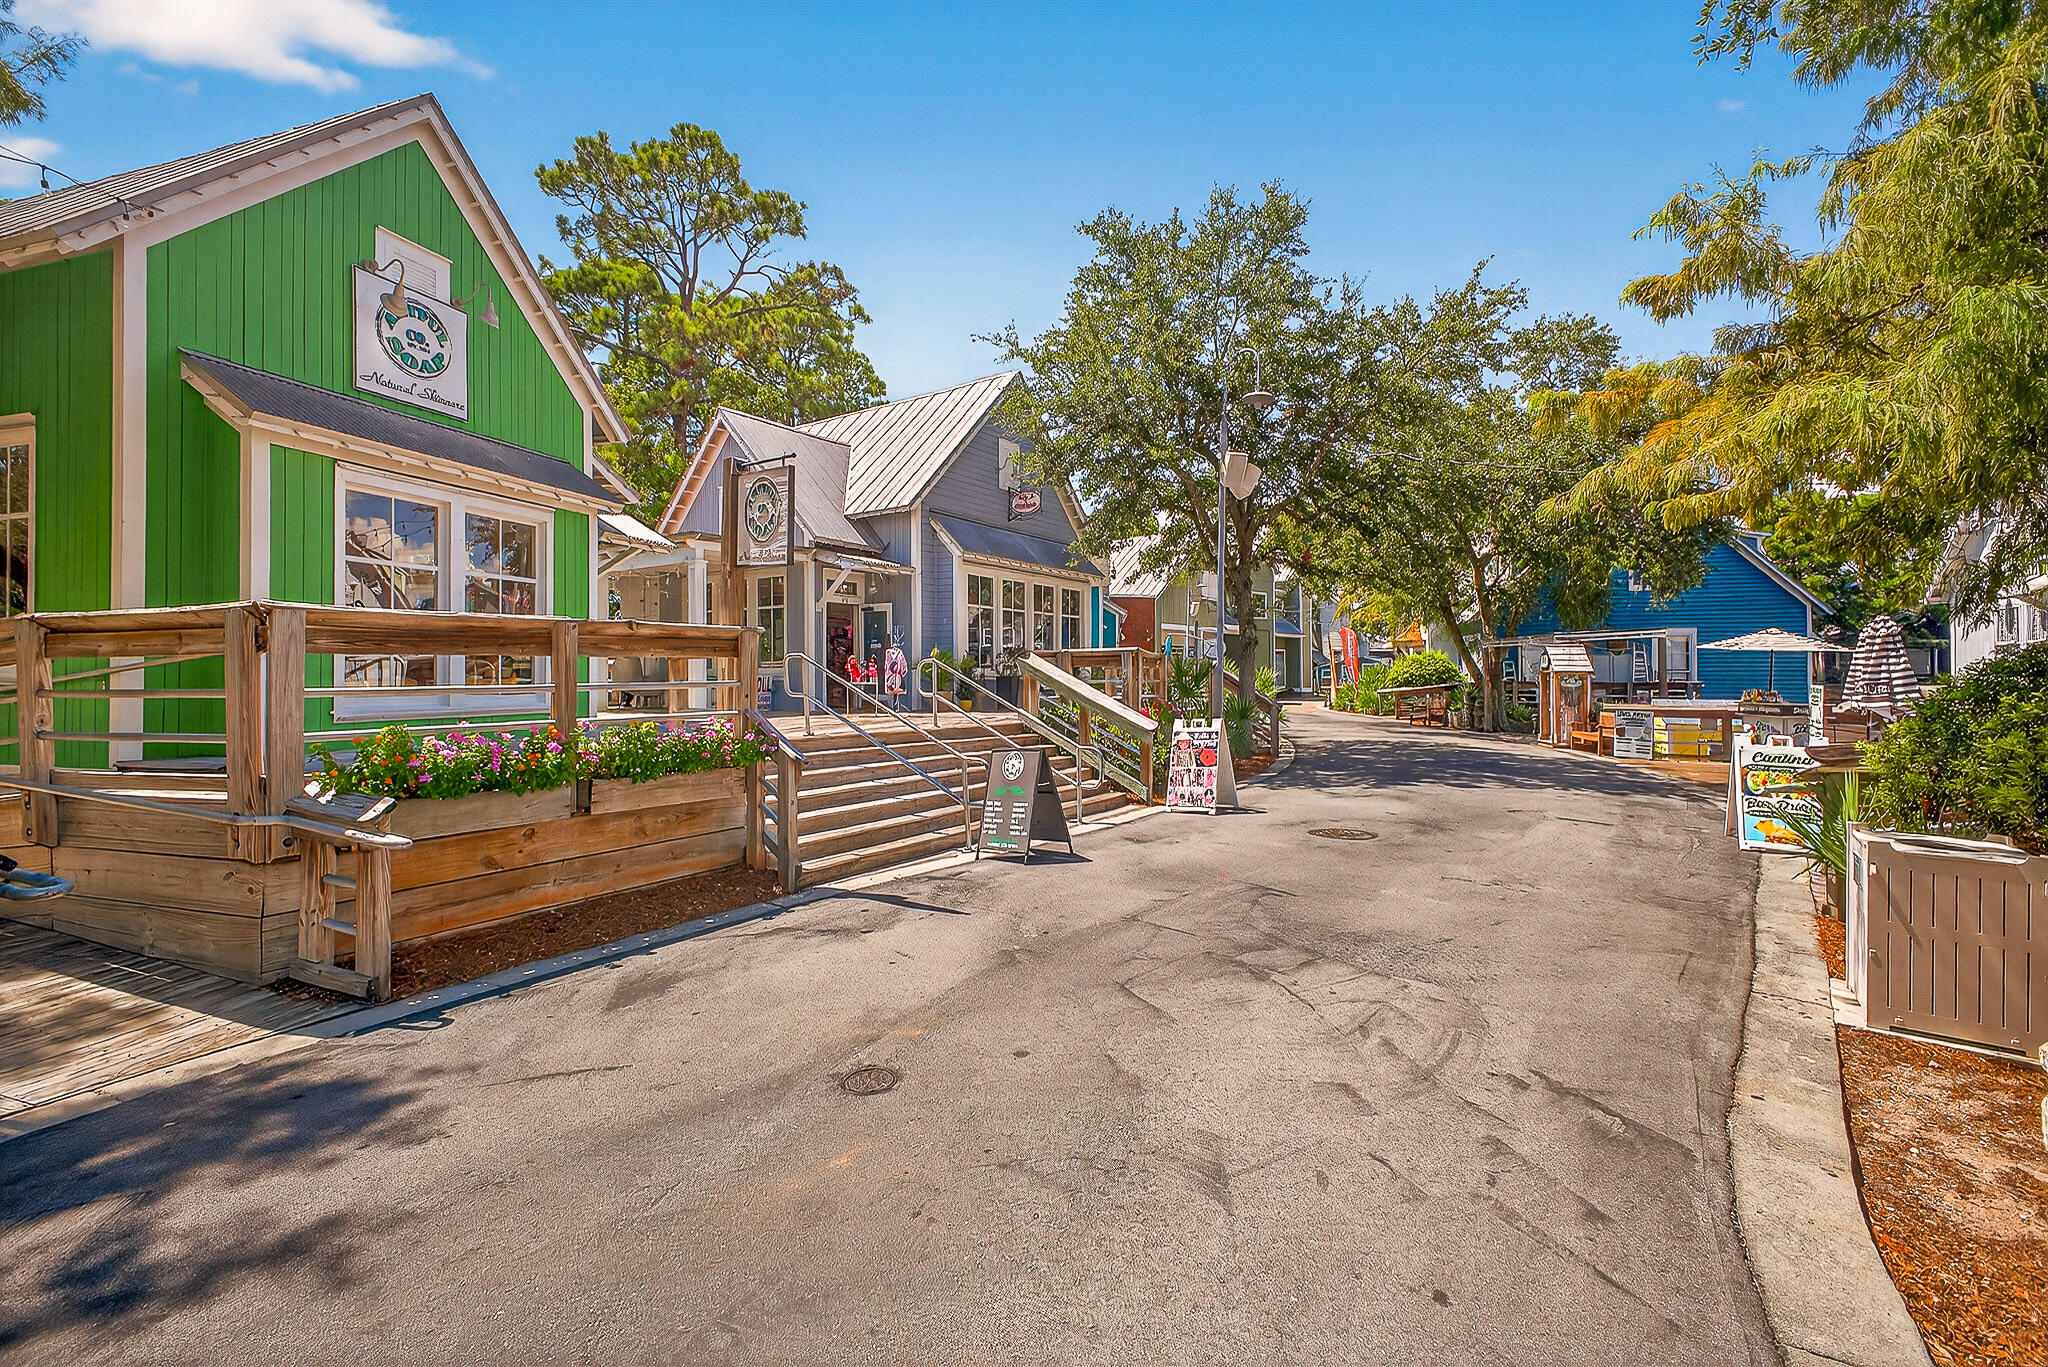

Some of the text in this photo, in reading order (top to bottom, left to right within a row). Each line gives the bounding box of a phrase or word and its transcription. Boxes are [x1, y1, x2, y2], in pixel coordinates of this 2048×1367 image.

[384, 336, 445, 374] SOAP
[359, 371, 418, 396] Natural
[1751, 751, 1815, 766] Cantina
